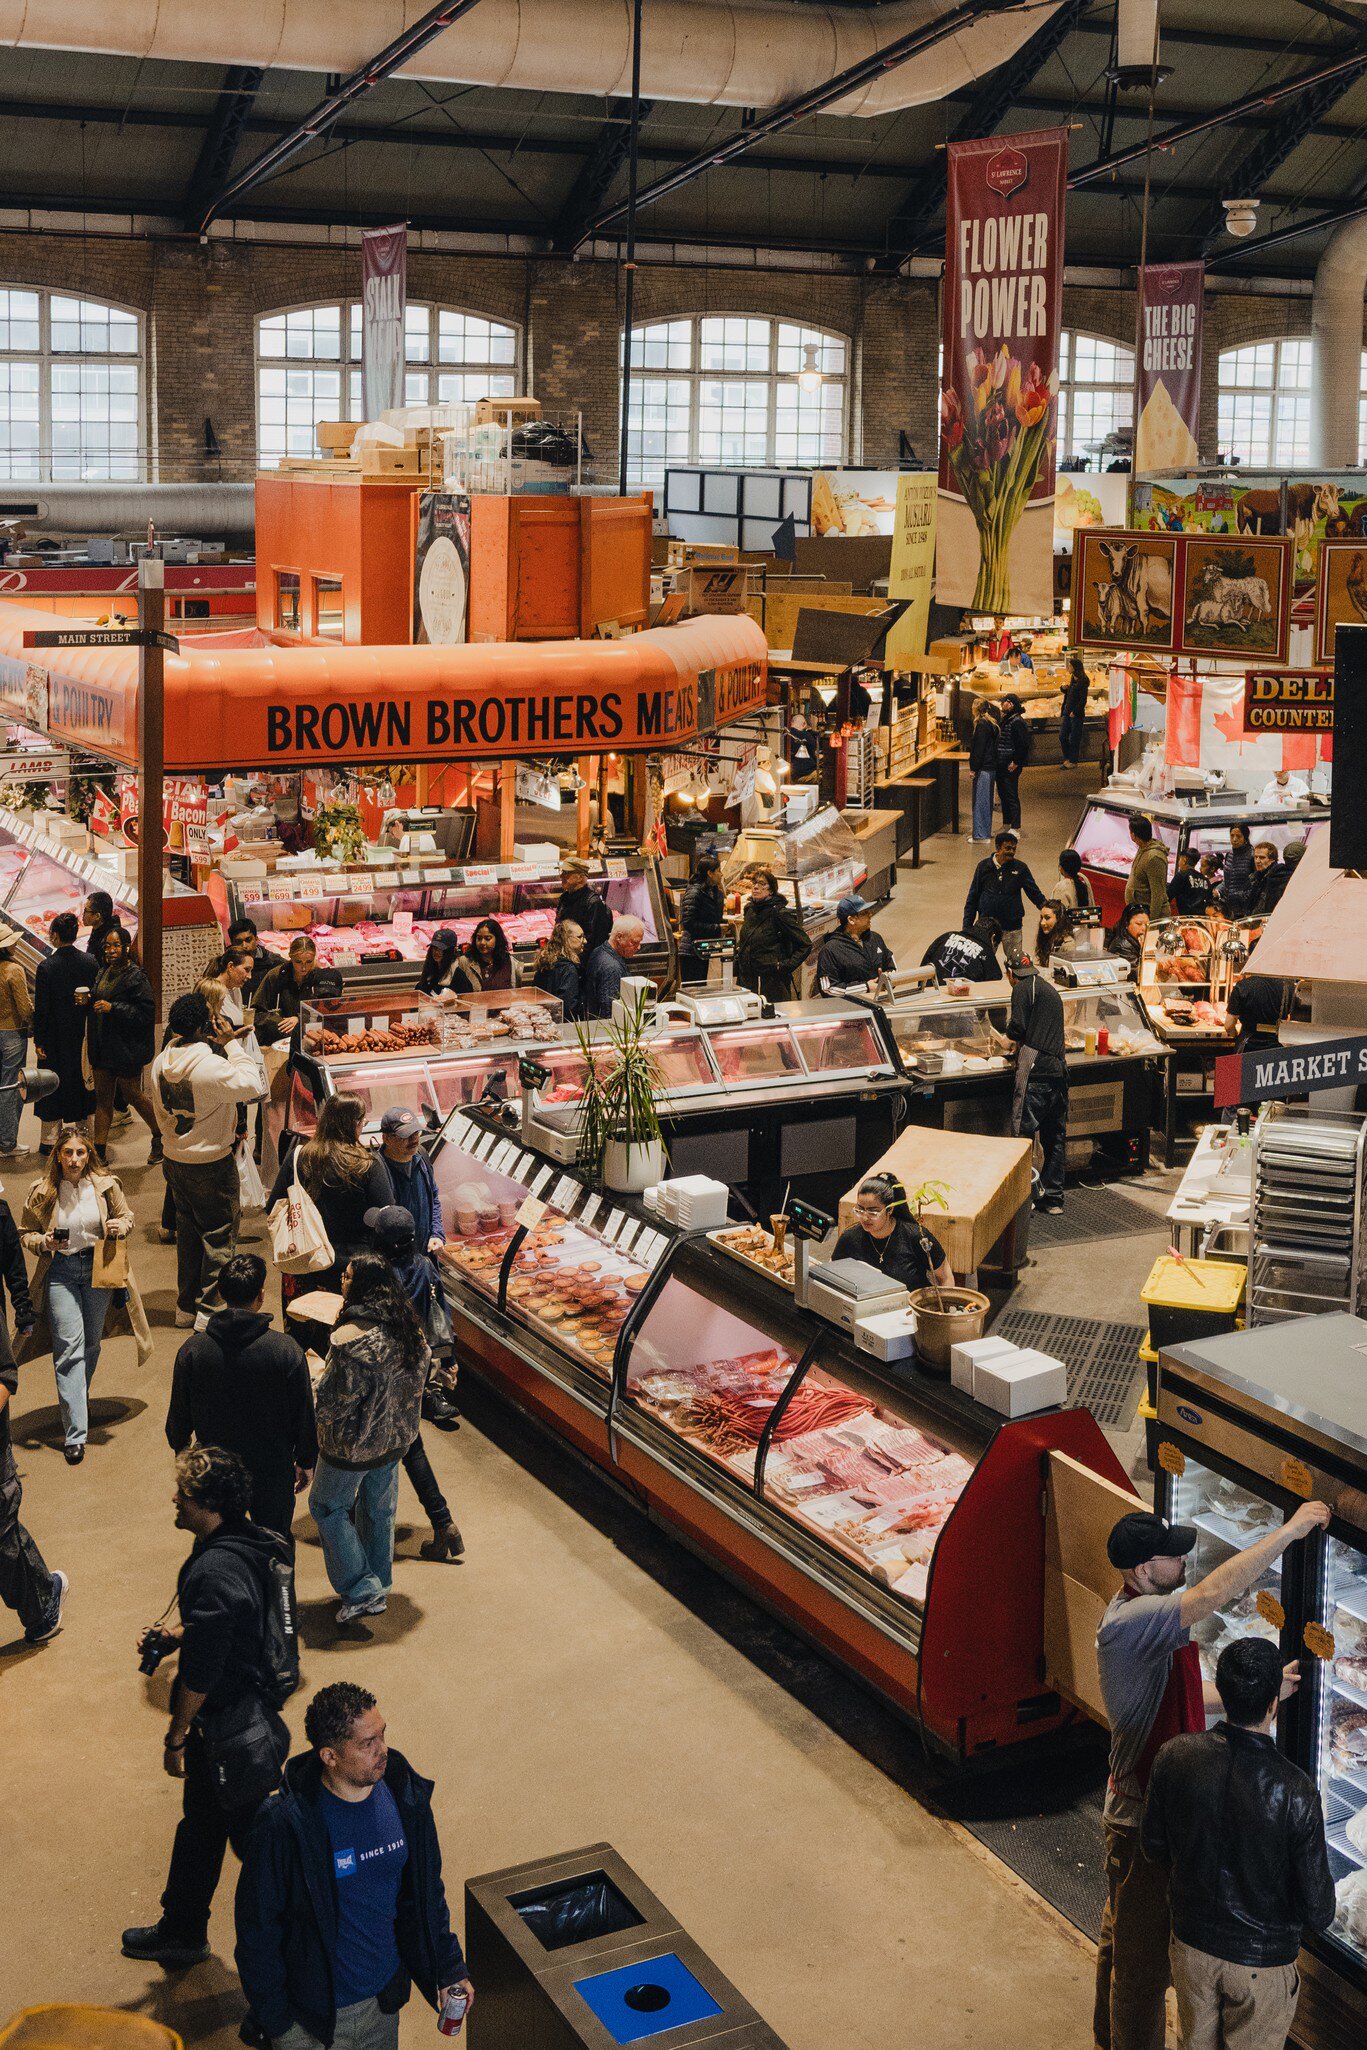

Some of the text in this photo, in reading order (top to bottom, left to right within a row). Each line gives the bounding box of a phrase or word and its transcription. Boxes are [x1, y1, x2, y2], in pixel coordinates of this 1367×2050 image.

[996, 169, 1022, 177] LAWRENCE
[961, 213, 1048, 273] FLOWER
[366, 274, 401, 322] STALK
[961, 275, 1047, 338] POWER
[1145, 303, 1195, 336] THE BIG
[1143, 337, 1193, 371] CHEESE
[58, 633, 131, 644] MAIN STREET
[63, 684, 113, 736] POULTRY
[267, 701, 411, 752] BROWN
[427, 693, 623, 745] BROTHERS
[718, 672, 725, 713] &
[727, 661, 760, 709] POULTRY
[171, 801, 206, 825] Bacon
[188, 827, 206, 840] ONLY
[465, 869, 490, 877] Special
[244, 893, 260, 902] 599
[303, 888, 320, 896] 499
[1254, 1051, 1351, 1088] MARKET
[281, 1586, 290, 1612] CONCEPT
[360, 1847, 385, 1861] SINCE
[387, 1839, 404, 1851] 1910
